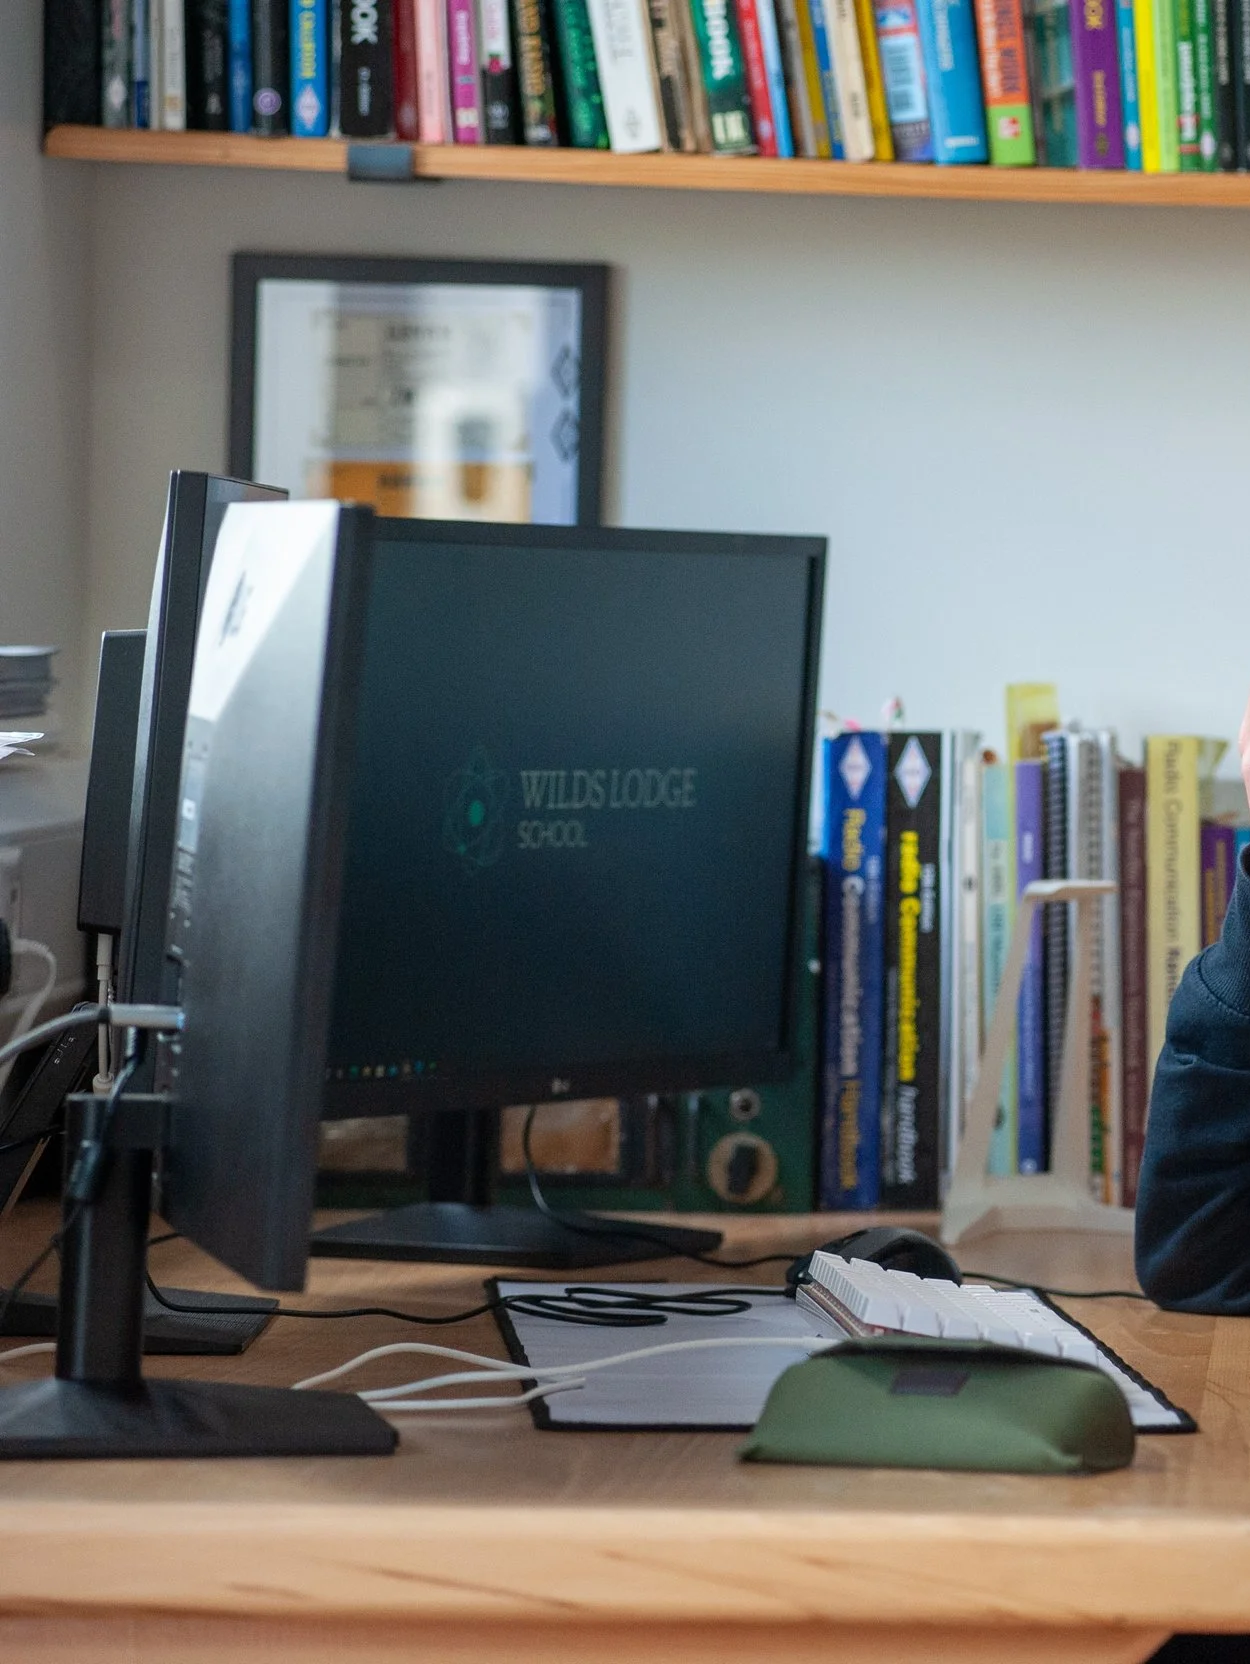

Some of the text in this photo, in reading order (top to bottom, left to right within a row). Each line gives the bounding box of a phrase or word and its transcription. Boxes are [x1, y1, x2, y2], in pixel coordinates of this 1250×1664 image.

[609, 767, 699, 809] LODGE
[842, 808, 866, 872] Radio
[839, 875, 865, 1076] Communication
